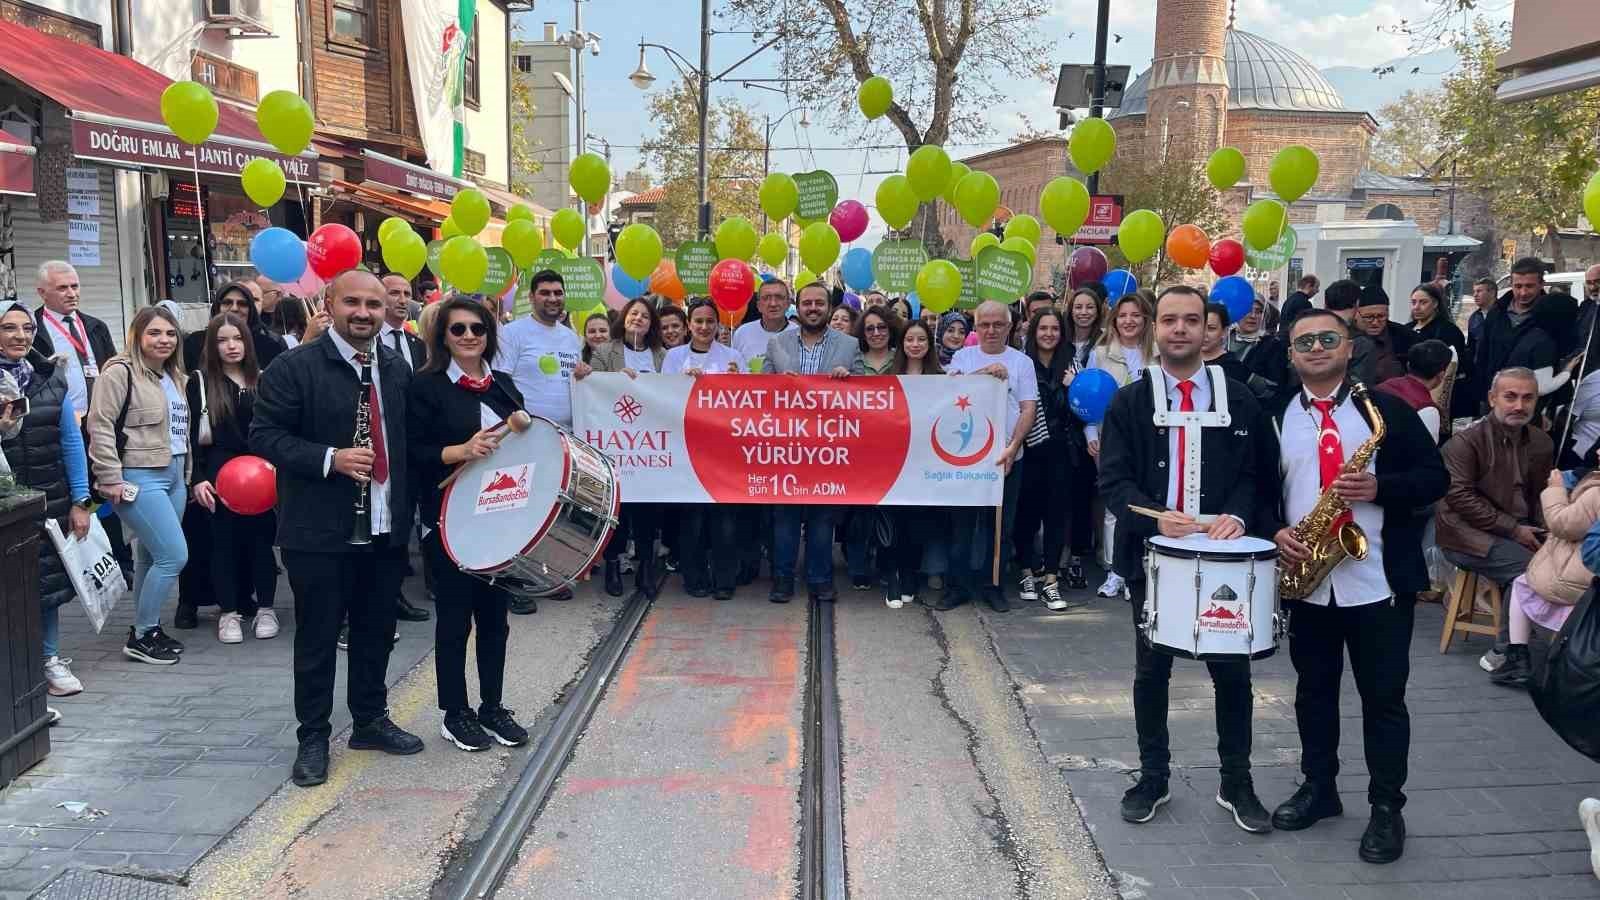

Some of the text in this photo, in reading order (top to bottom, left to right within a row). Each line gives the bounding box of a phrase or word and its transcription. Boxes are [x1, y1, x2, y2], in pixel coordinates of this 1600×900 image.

[90, 129, 138, 153] DOĞRU
[142, 139, 181, 160] EMLAK
[199, 147, 233, 167] JANTİ
[283, 159, 309, 177] VALİZ
[698, 386, 895, 410] HAYAT HASTANESİ
[730, 413, 860, 442] SAĞLIK İÇİN
[585, 429, 672, 450] HAYAT
[608, 451, 672, 468] STANESİ
[742, 442, 850, 465] YÜRÜYOR
[747, 473, 768, 484] Her
[748, 485, 768, 496] gün
